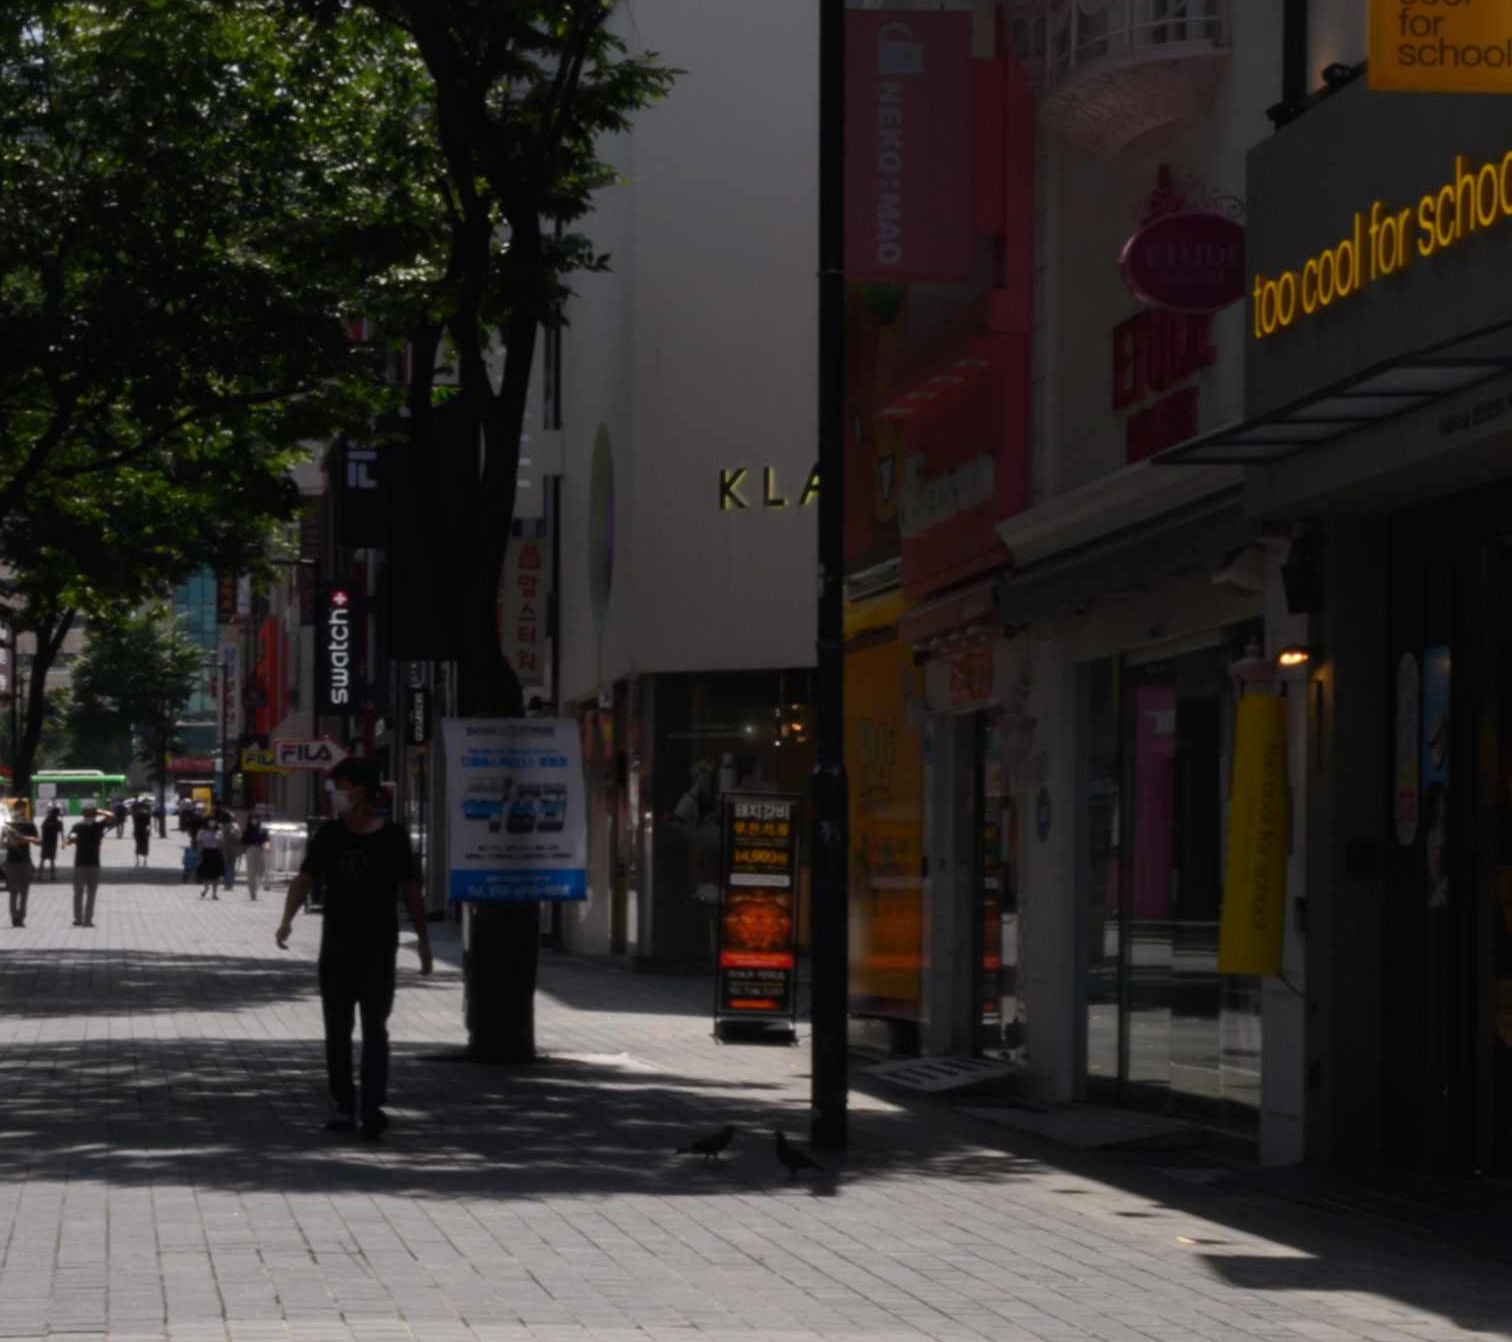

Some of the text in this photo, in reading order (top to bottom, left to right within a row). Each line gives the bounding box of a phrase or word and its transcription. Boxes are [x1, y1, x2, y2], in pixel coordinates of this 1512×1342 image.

[1399, 7, 1445, 38] for
[1398, 37, 1512, 68] school
[1252, 273, 1297, 340] too
[1301, 211, 1364, 315] cool
[1368, 199, 1413, 281] for
[328, 608, 349, 704] swatch
[280, 743, 332, 763] FILA
